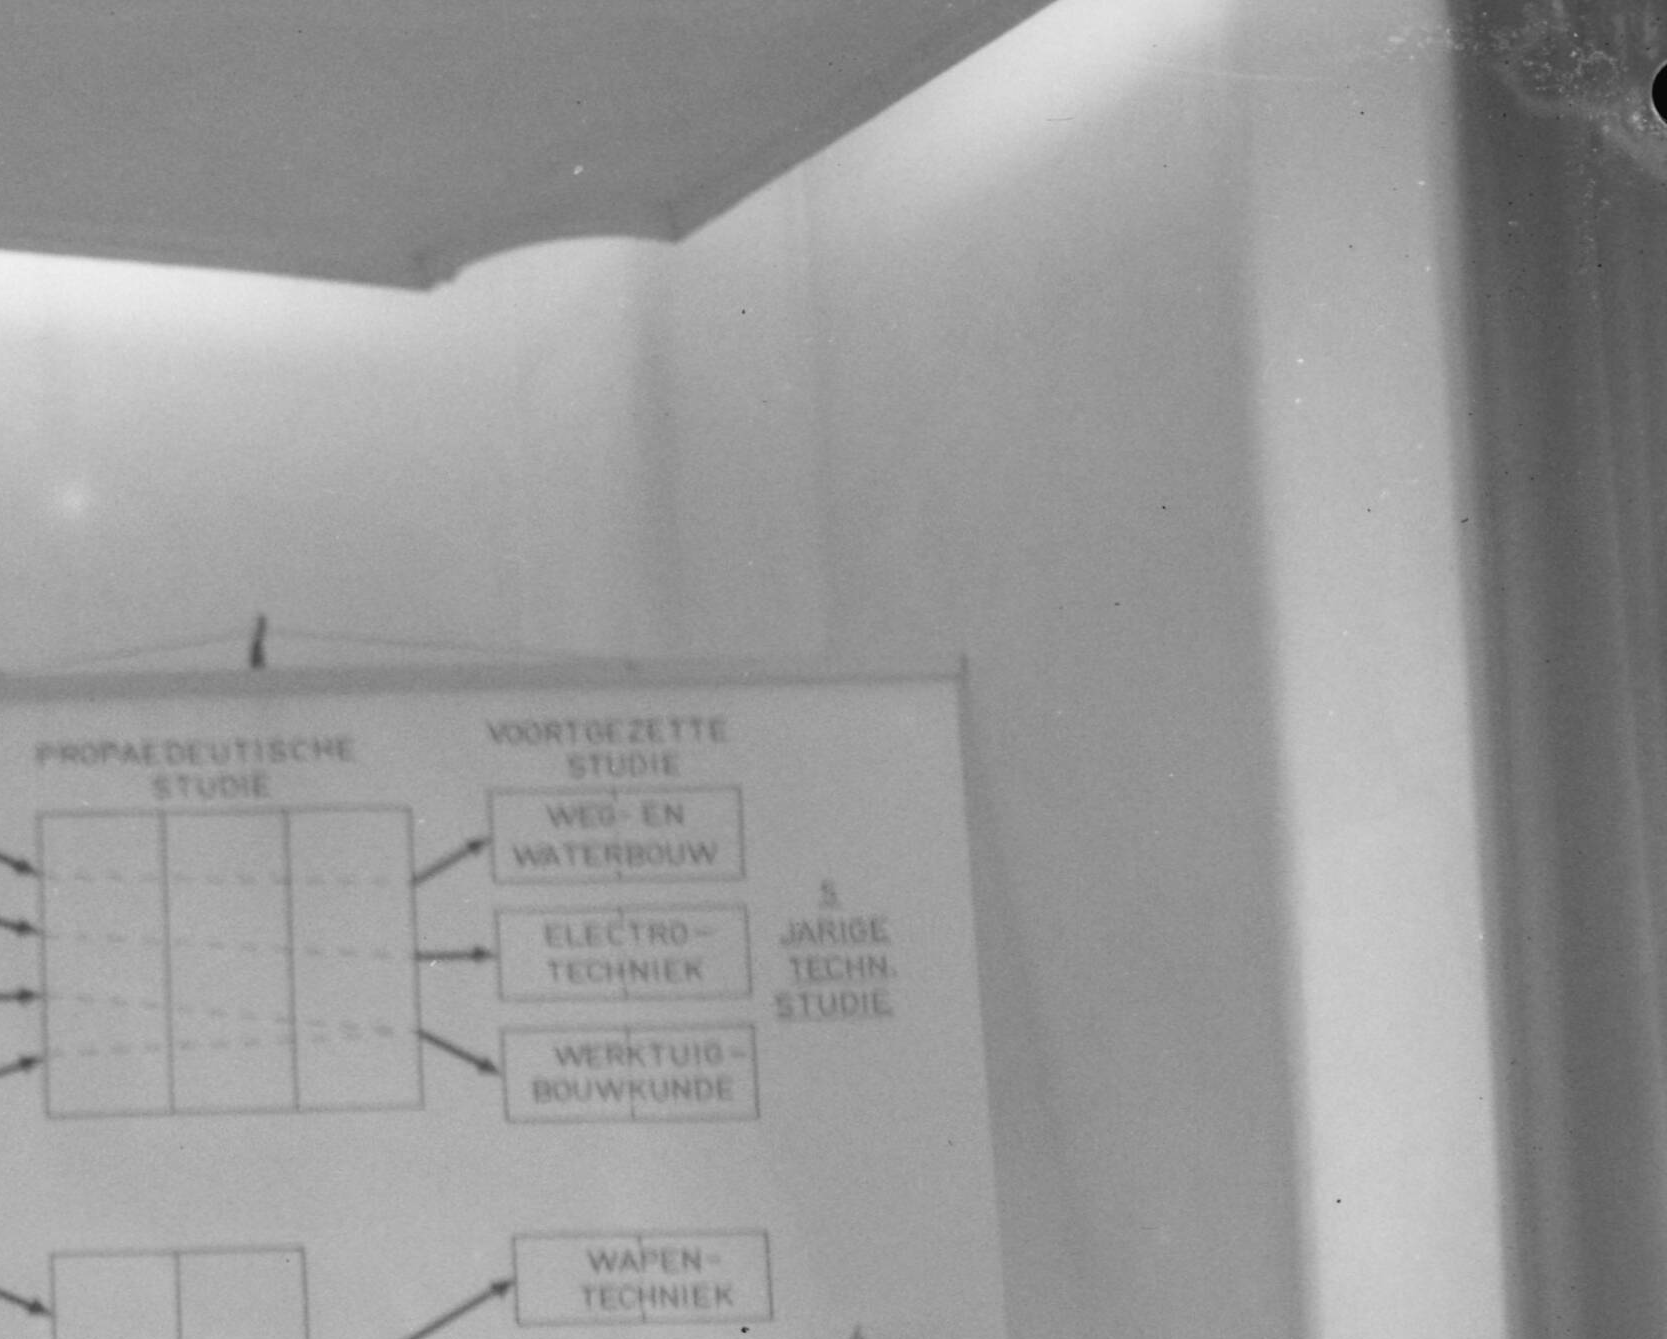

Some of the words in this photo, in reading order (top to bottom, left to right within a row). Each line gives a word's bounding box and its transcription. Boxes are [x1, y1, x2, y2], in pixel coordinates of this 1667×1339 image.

[568, 754, 681, 780] STUDIE
[152, 772, 271, 800] STUDIE
[640, 803, 685, 827] EN
[512, 841, 720, 869] WATERBOUW
[548, 959, 705, 985] TECHNIEK
[774, 987, 895, 1019] STUDIE
[531, 1076, 735, 1105] BOUWKUNDE
[580, 1282, 735, 1309] TECHNIEK
